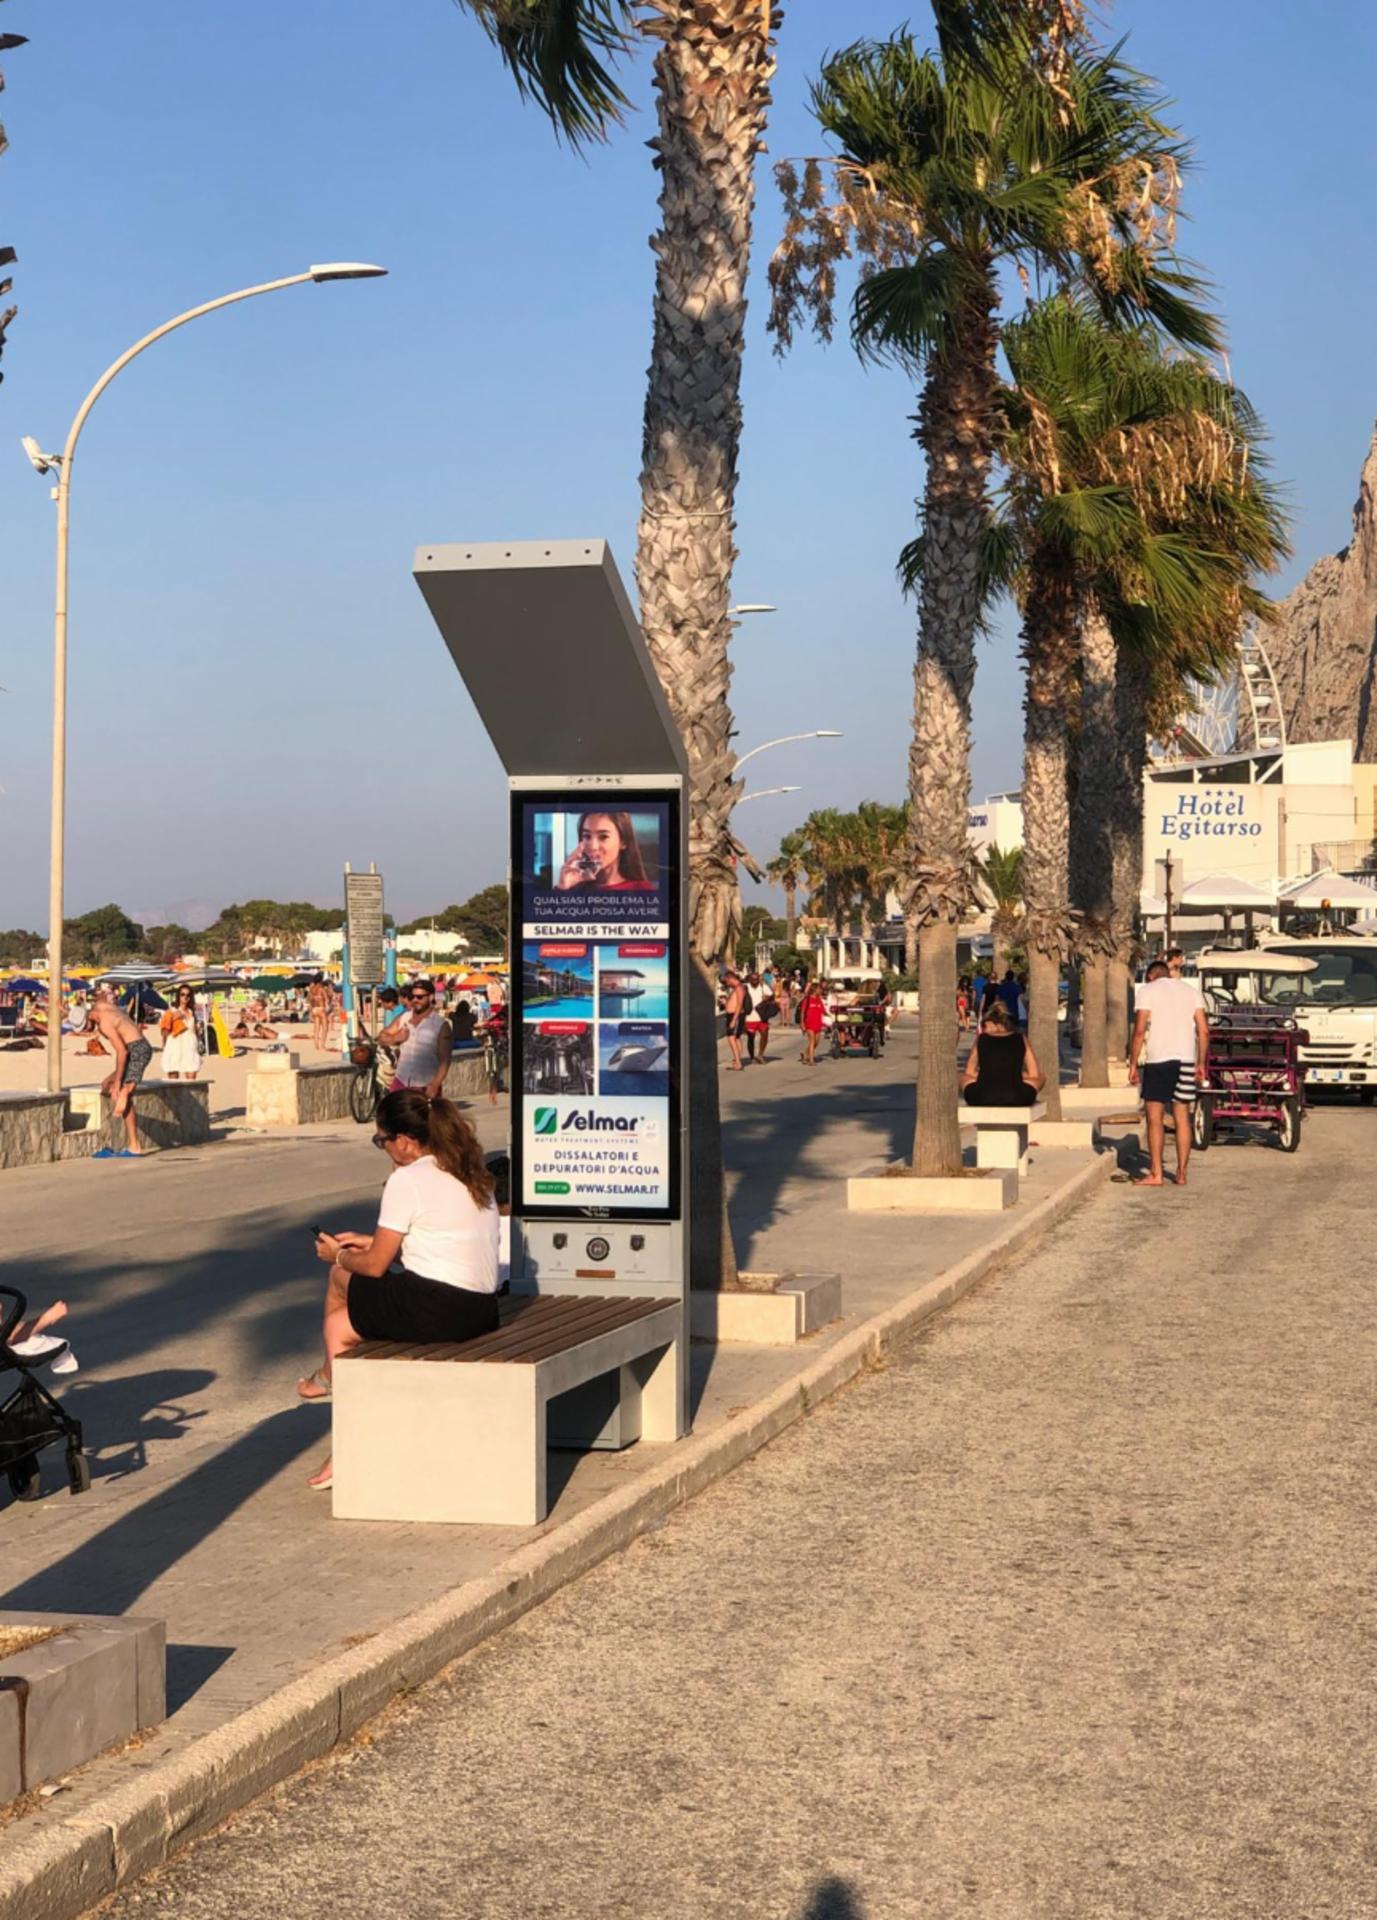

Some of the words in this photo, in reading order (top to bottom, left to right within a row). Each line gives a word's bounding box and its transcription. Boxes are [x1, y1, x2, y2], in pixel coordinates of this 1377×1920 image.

[1177, 795, 1244, 816] Hotel
[1160, 815, 1262, 840] Egitarso
[533, 896, 586, 906] QUALSIASI
[587, 896, 645, 905] PROBLEMA
[646, 896, 660, 905] LA
[534, 907, 554, 916] TUA
[555, 907, 591, 916] ACQUA
[592, 907, 626, 916] POSSA
[627, 907, 660, 916] AVERE
[534, 925, 584, 935] SELMAR
[587, 925, 598, 935] IS
[599, 925, 625, 935] THE
[628, 925, 659, 935] WAY
[561, 1109, 638, 1131] Selmar
[554, 1150, 629, 1161] DISSALATORI
[632, 1151, 639, 1161] E
[533, 1163, 605, 1174] DEPURATORI
[608, 1164, 660, 1175] D'ACQUA
[575, 1183, 660, 1195] WWW.SELMAR.IT
